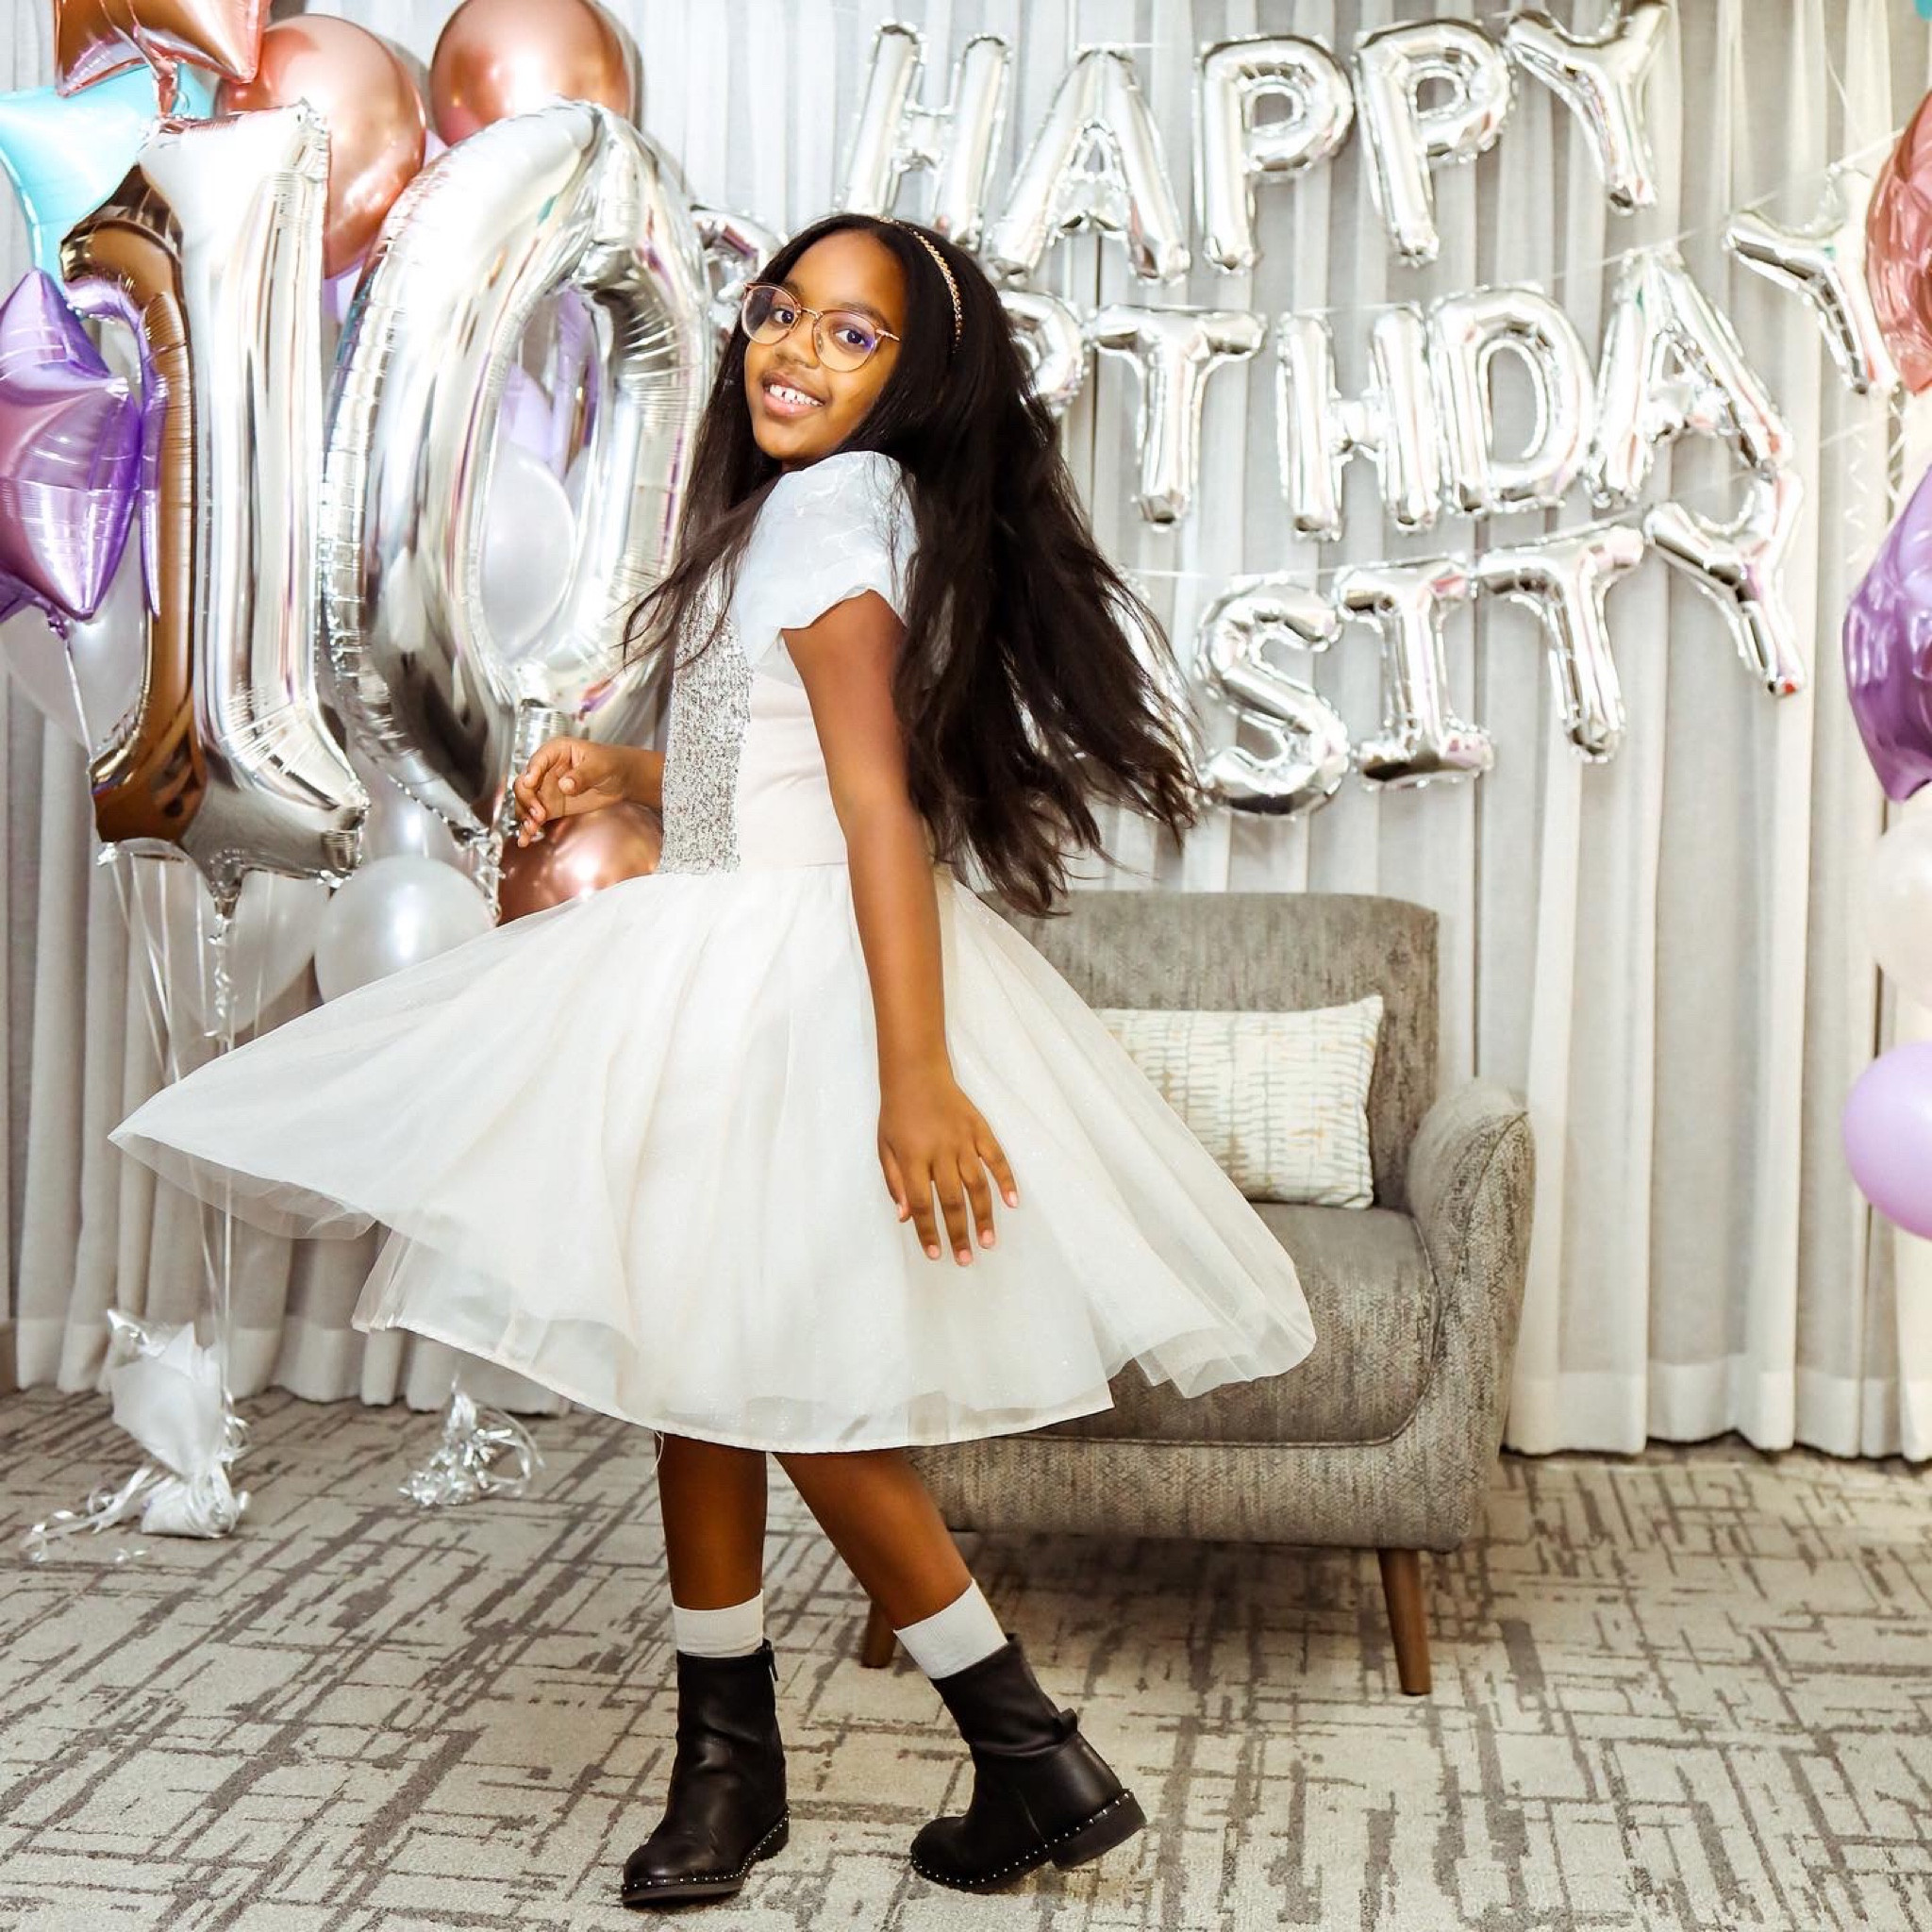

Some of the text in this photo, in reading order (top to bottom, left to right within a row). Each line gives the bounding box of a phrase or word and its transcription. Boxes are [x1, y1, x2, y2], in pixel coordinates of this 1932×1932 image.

[836, 1, 1670, 285] HAPPY
[61, 99, 712, 882] 10
[691, 163, 1900, 541] THDAY
